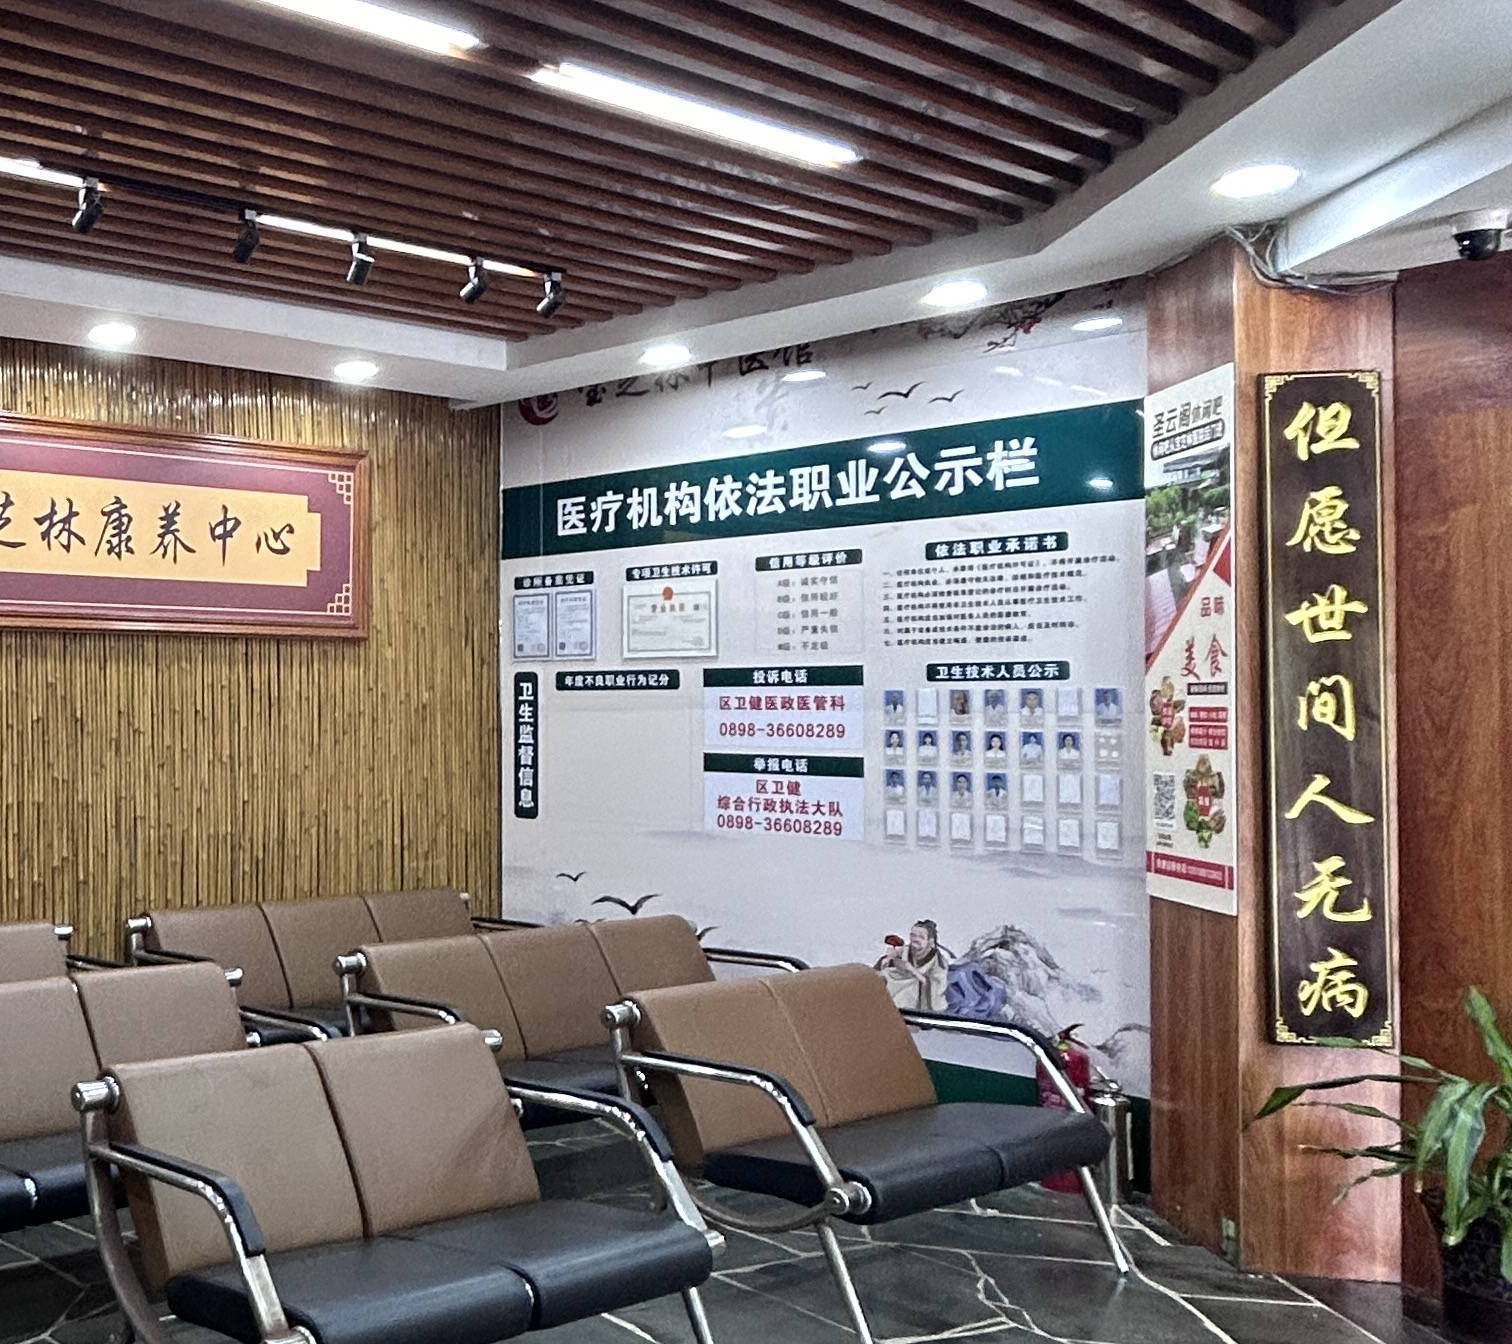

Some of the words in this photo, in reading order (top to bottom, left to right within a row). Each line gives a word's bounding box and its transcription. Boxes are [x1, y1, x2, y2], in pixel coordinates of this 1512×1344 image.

[556, 436, 1041, 538] 医疗机构依法职业公示栏
[934, 534, 1058, 558] 依法职业承诺书
[1181, 633, 1229, 681] 美食
[564, 674, 670, 688] 年度不良职业行为记分
[753, 669, 808, 684] 投诉电话
[935, 663, 1060, 679] 卫生技术人员公示
[719, 695, 845, 712] 区卫健医政医管科
[1283, 400, 1375, 1022] 但愿世间人无病
[719, 722, 846, 739] 0898-36608289
[518, 682, 534, 808] 卫生监督信息
[753, 757, 809, 773] 举报电话
[756, 779, 801, 797] 区卫健
[717, 795, 843, 817] 综合行政执法大队
[717, 814, 843, 836] 0898-36608289
